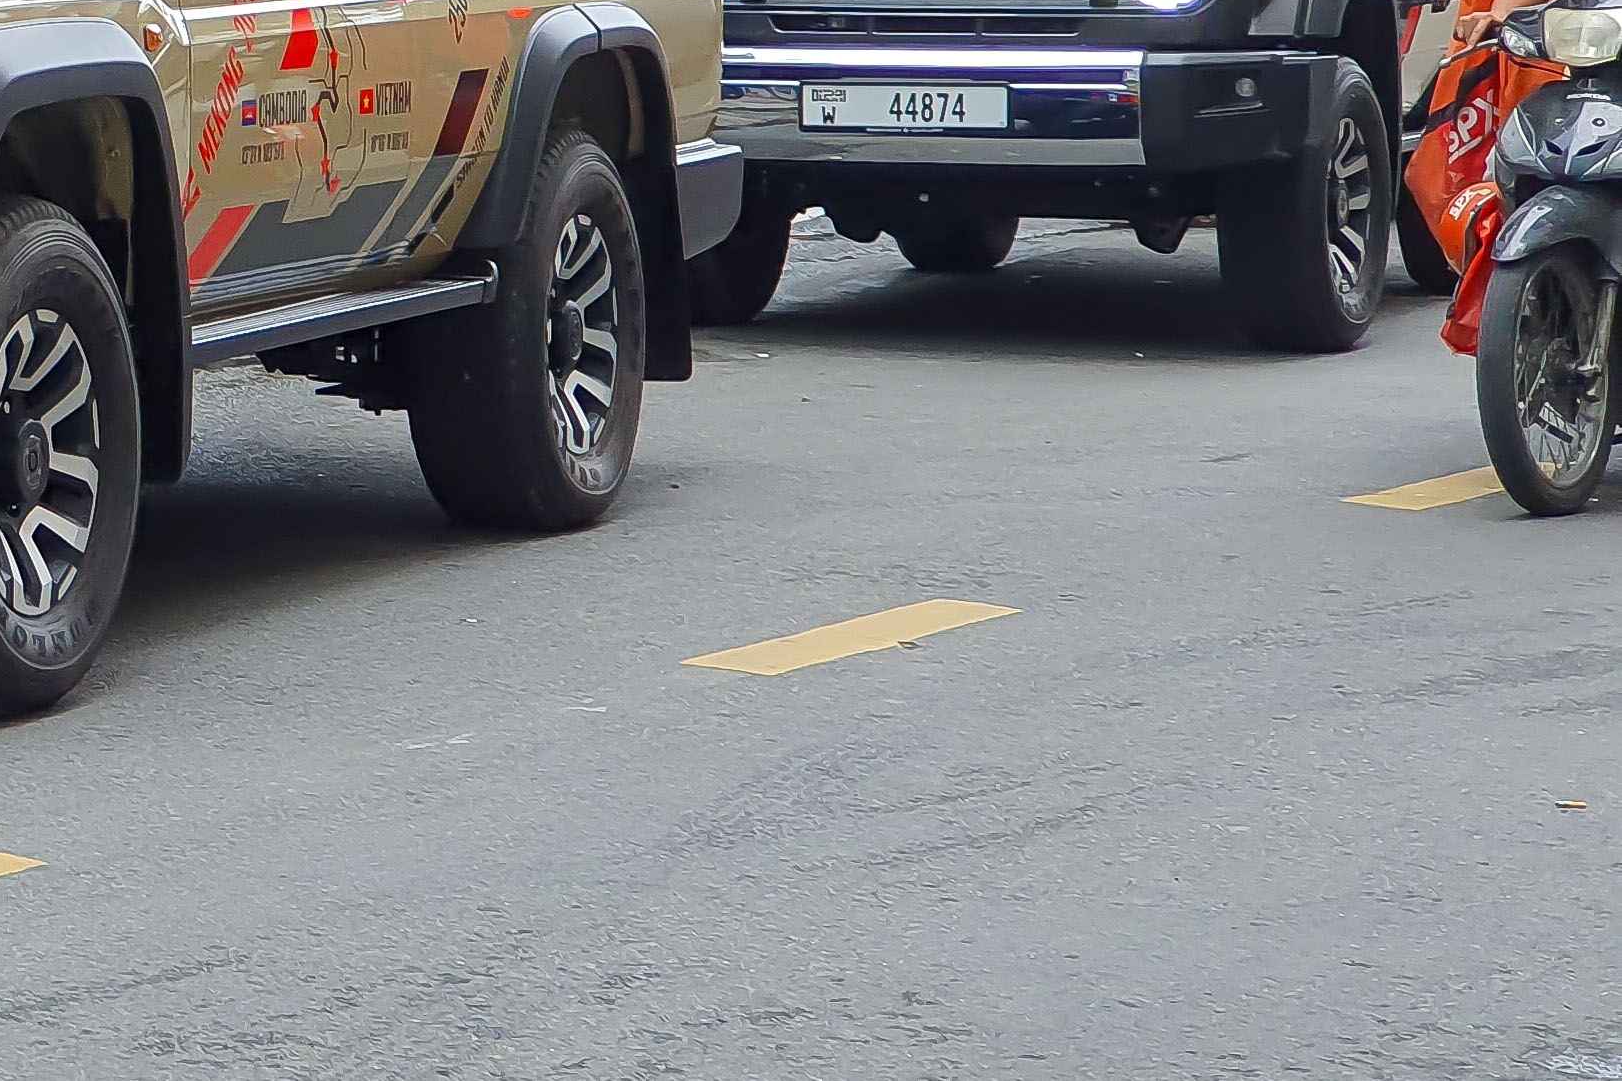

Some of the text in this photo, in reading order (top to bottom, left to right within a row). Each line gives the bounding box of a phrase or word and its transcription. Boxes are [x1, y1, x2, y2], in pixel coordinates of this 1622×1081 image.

[197, 45, 245, 175] MEKONG
[259, 89, 308, 129] CAMBODIA
[375, 81, 412, 116] VIETNAM
[821, 106, 836, 124] W
[889, 92, 966, 123] 44874
[1443, 89, 1500, 153] SPX
